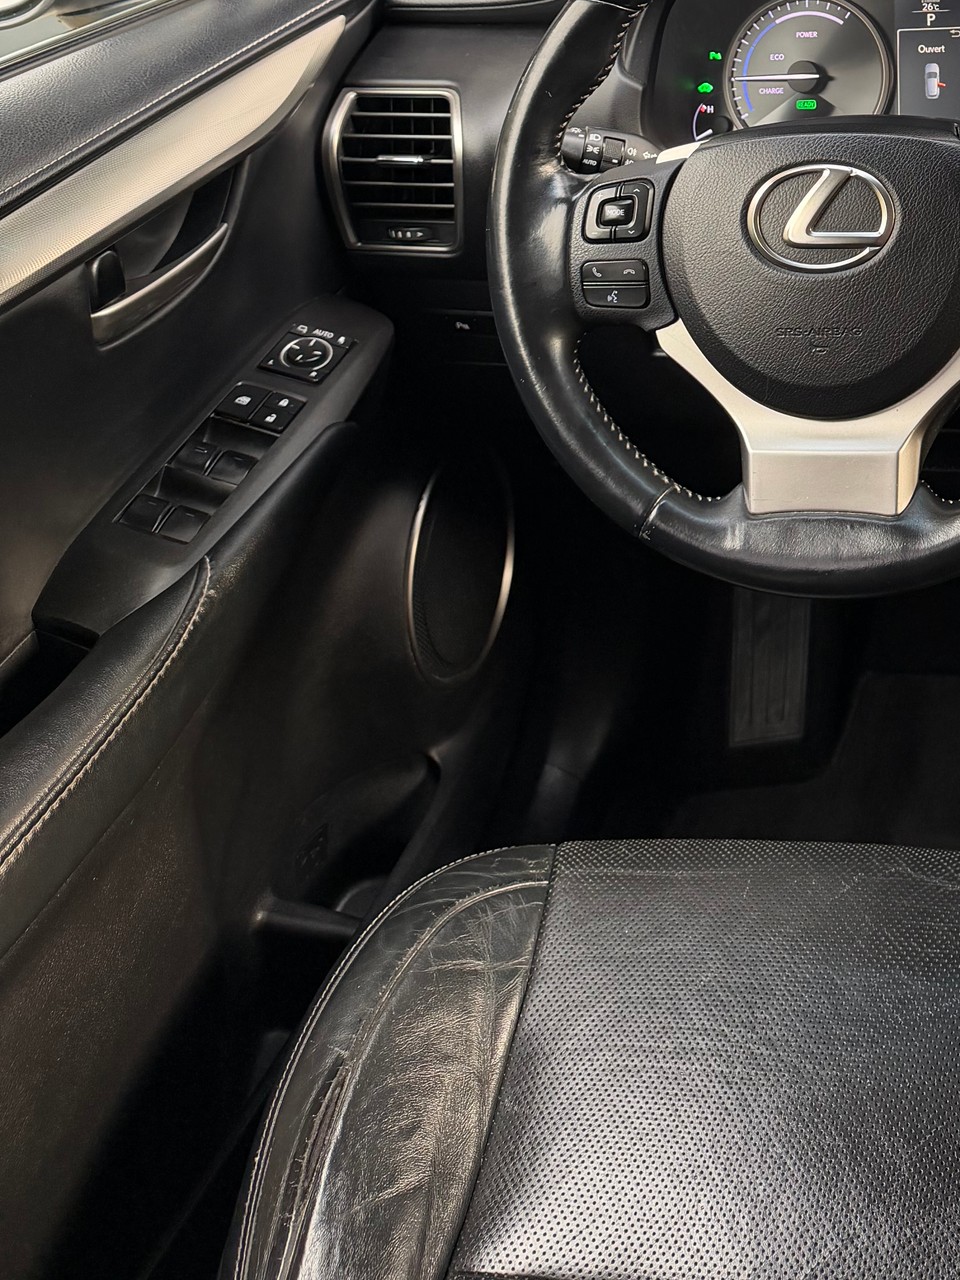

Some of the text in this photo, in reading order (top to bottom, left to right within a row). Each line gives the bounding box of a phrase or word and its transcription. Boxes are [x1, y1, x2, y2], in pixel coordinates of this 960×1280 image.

[926, 13, 936, 26] P
[917, 44, 945, 54] Ouvert
[769, 53, 785, 61] ECO
[706, 105, 714, 114] H
[582, 158, 598, 166] AUTO
[607, 208, 625, 216] MODE
[312, 328, 334, 339] AUTO
